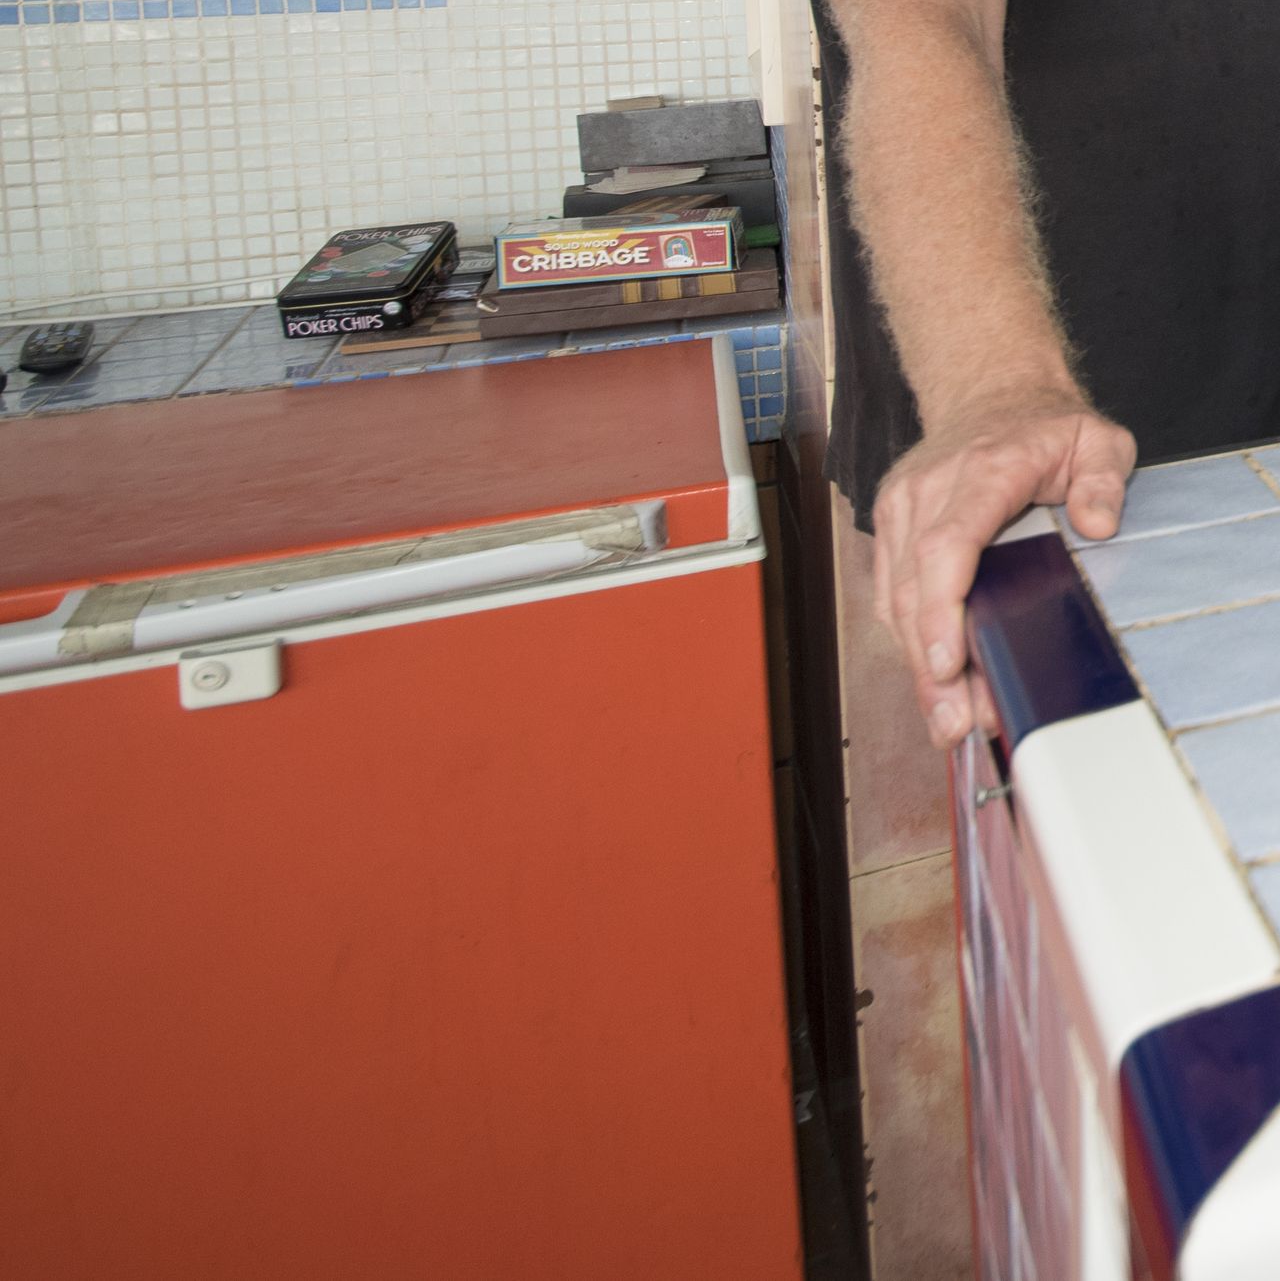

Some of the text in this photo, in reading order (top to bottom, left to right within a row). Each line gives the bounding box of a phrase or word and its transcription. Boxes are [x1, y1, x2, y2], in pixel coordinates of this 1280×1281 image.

[333, 224, 445, 244] POKER CHIPS
[543, 238, 619, 252] SOLID WOOD
[511, 246, 651, 273] CRIBBAGE
[287, 314, 385, 336] POKER CHIPS
